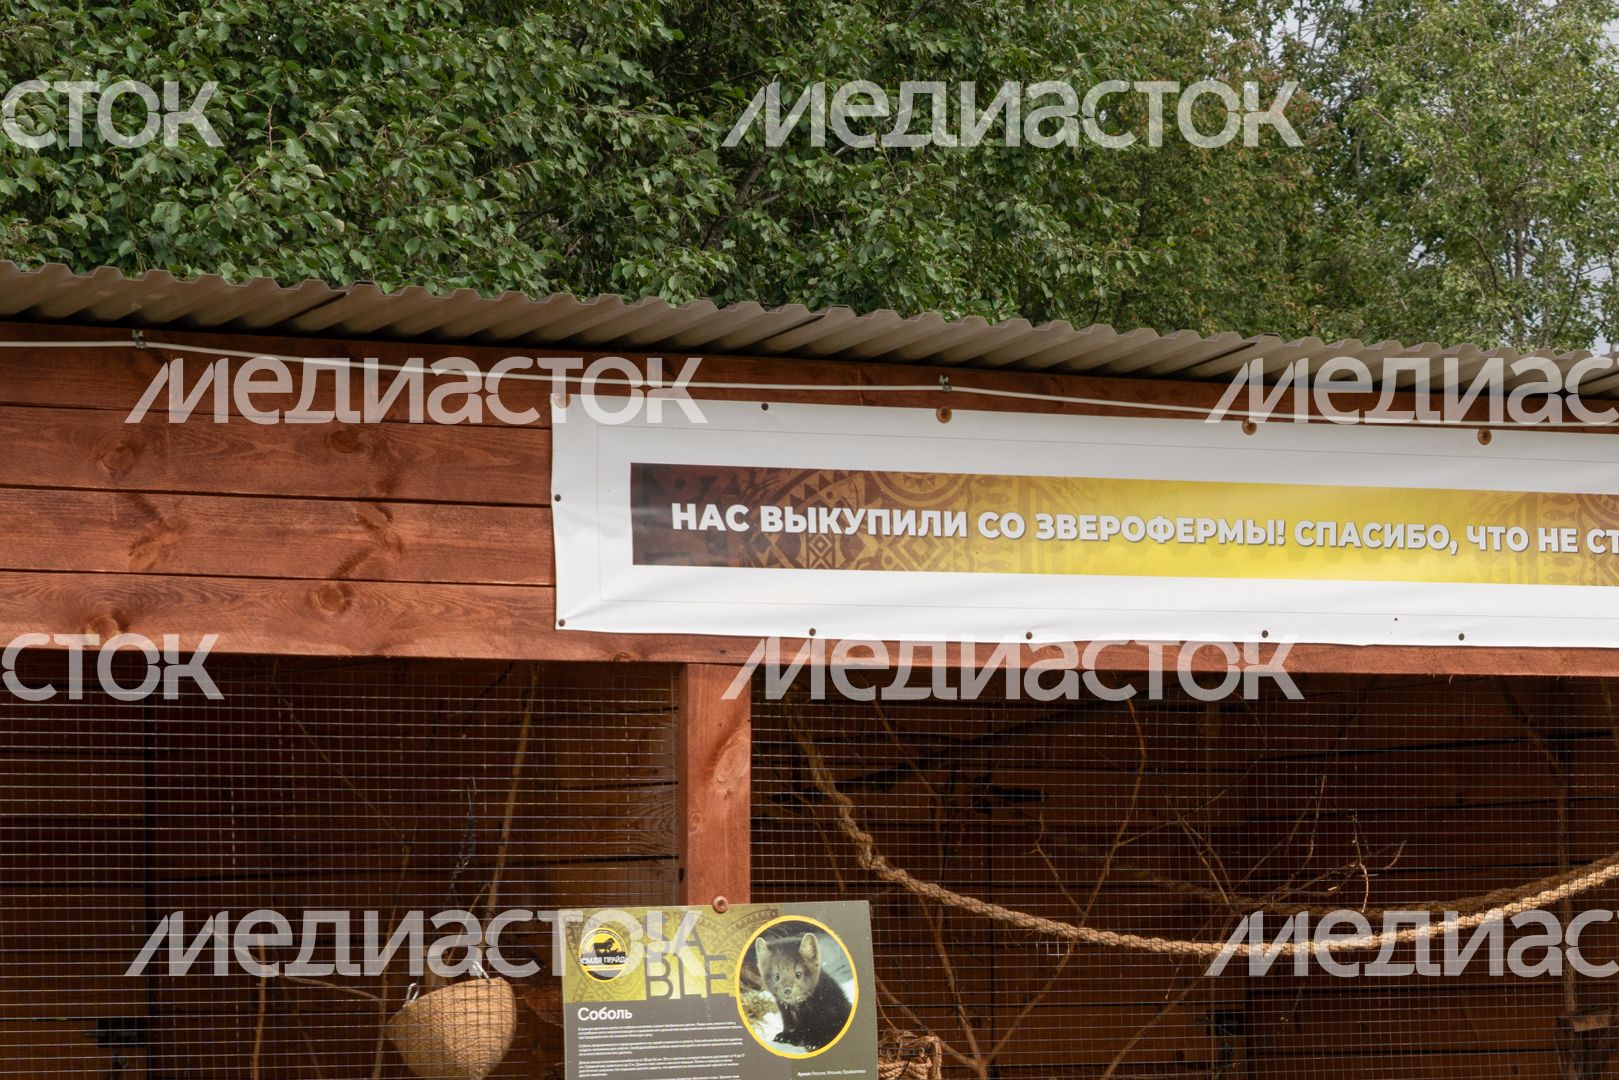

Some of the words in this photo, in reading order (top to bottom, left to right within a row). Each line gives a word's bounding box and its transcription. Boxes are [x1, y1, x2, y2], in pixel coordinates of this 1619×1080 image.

[671, 502, 750, 533] НАС
[760, 504, 968, 538] ВЫКУПИЛИ
[977, 511, 1026, 541] СО
[1035, 513, 1286, 548] ЗВЕРОФЕРМЫ!
[1294, 519, 1458, 556] СПАСИБО,
[1466, 526, 1530, 553] ЧТО
[1538, 527, 1579, 554] НЕ
[577, 1006, 633, 1021] Соболь
